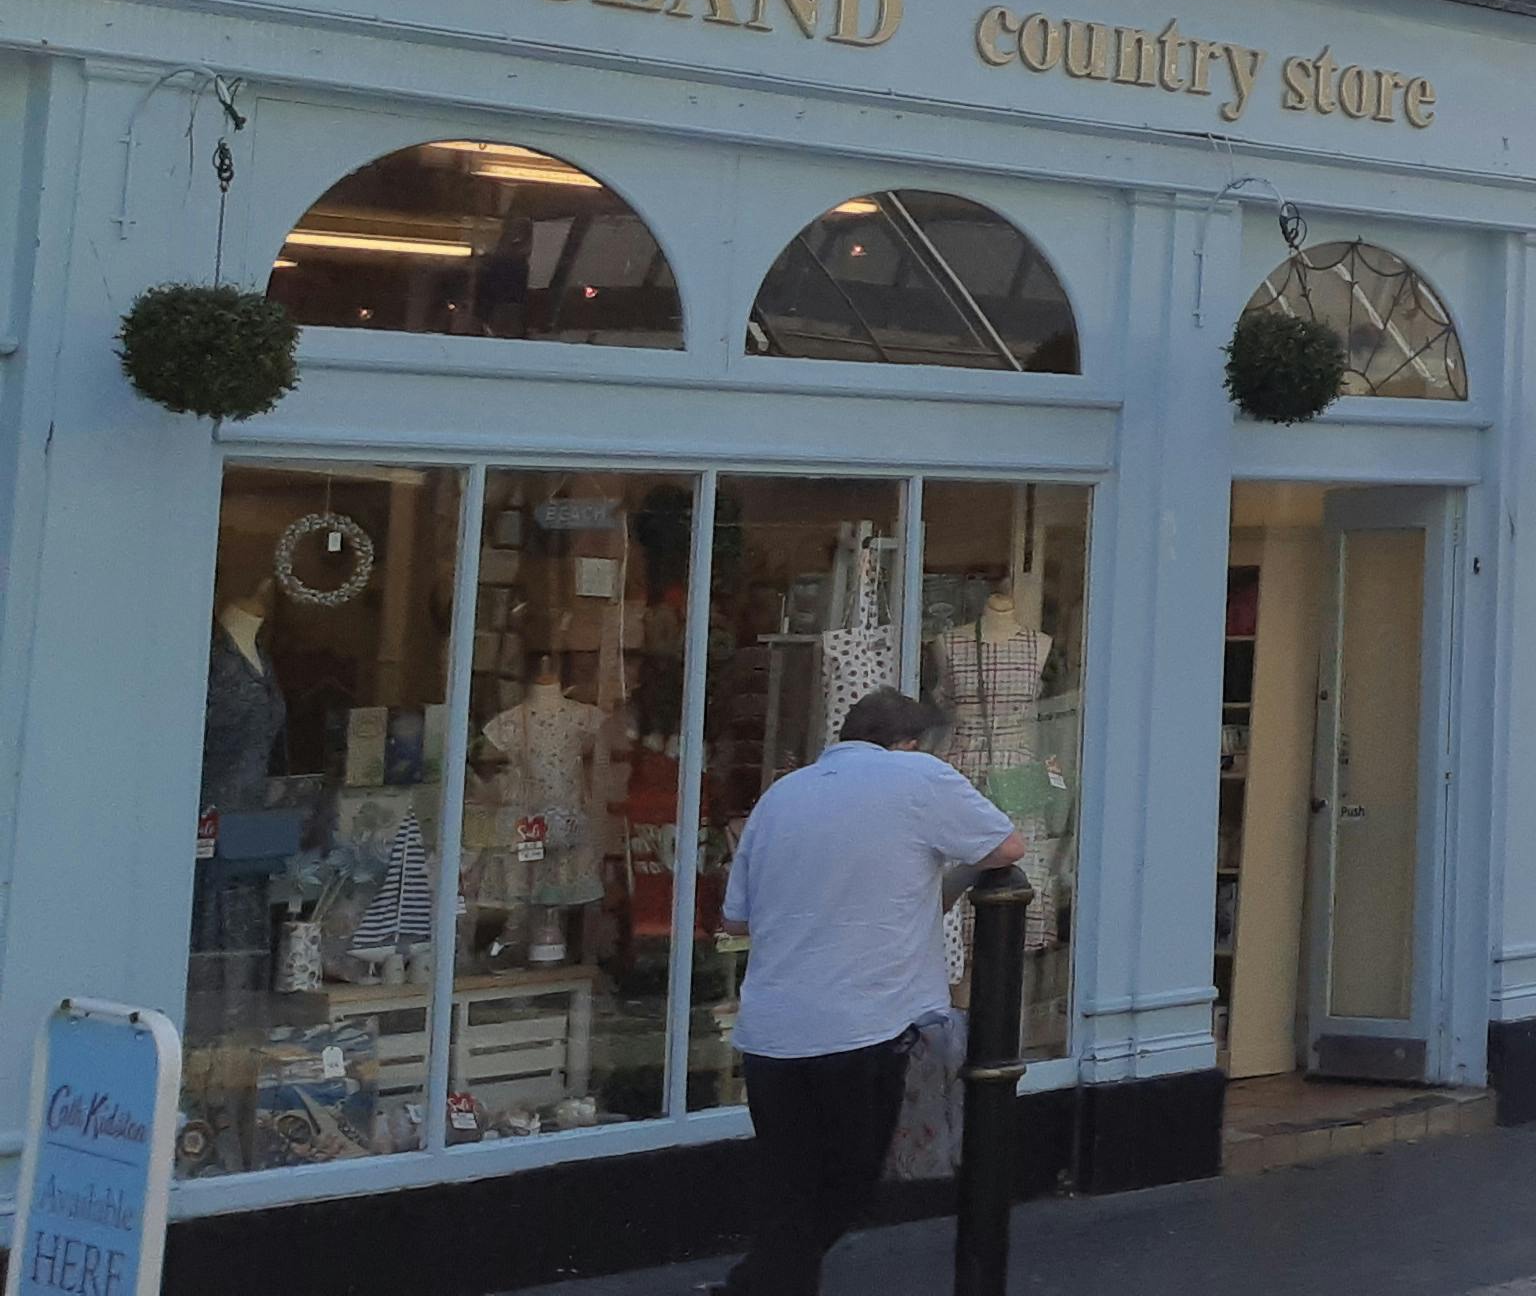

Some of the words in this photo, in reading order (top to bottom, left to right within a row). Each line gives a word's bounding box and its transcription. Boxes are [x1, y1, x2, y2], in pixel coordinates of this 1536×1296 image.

[974, 5, 1267, 122] country
[1281, 45, 1437, 129] store
[1340, 804, 1366, 817] Push
